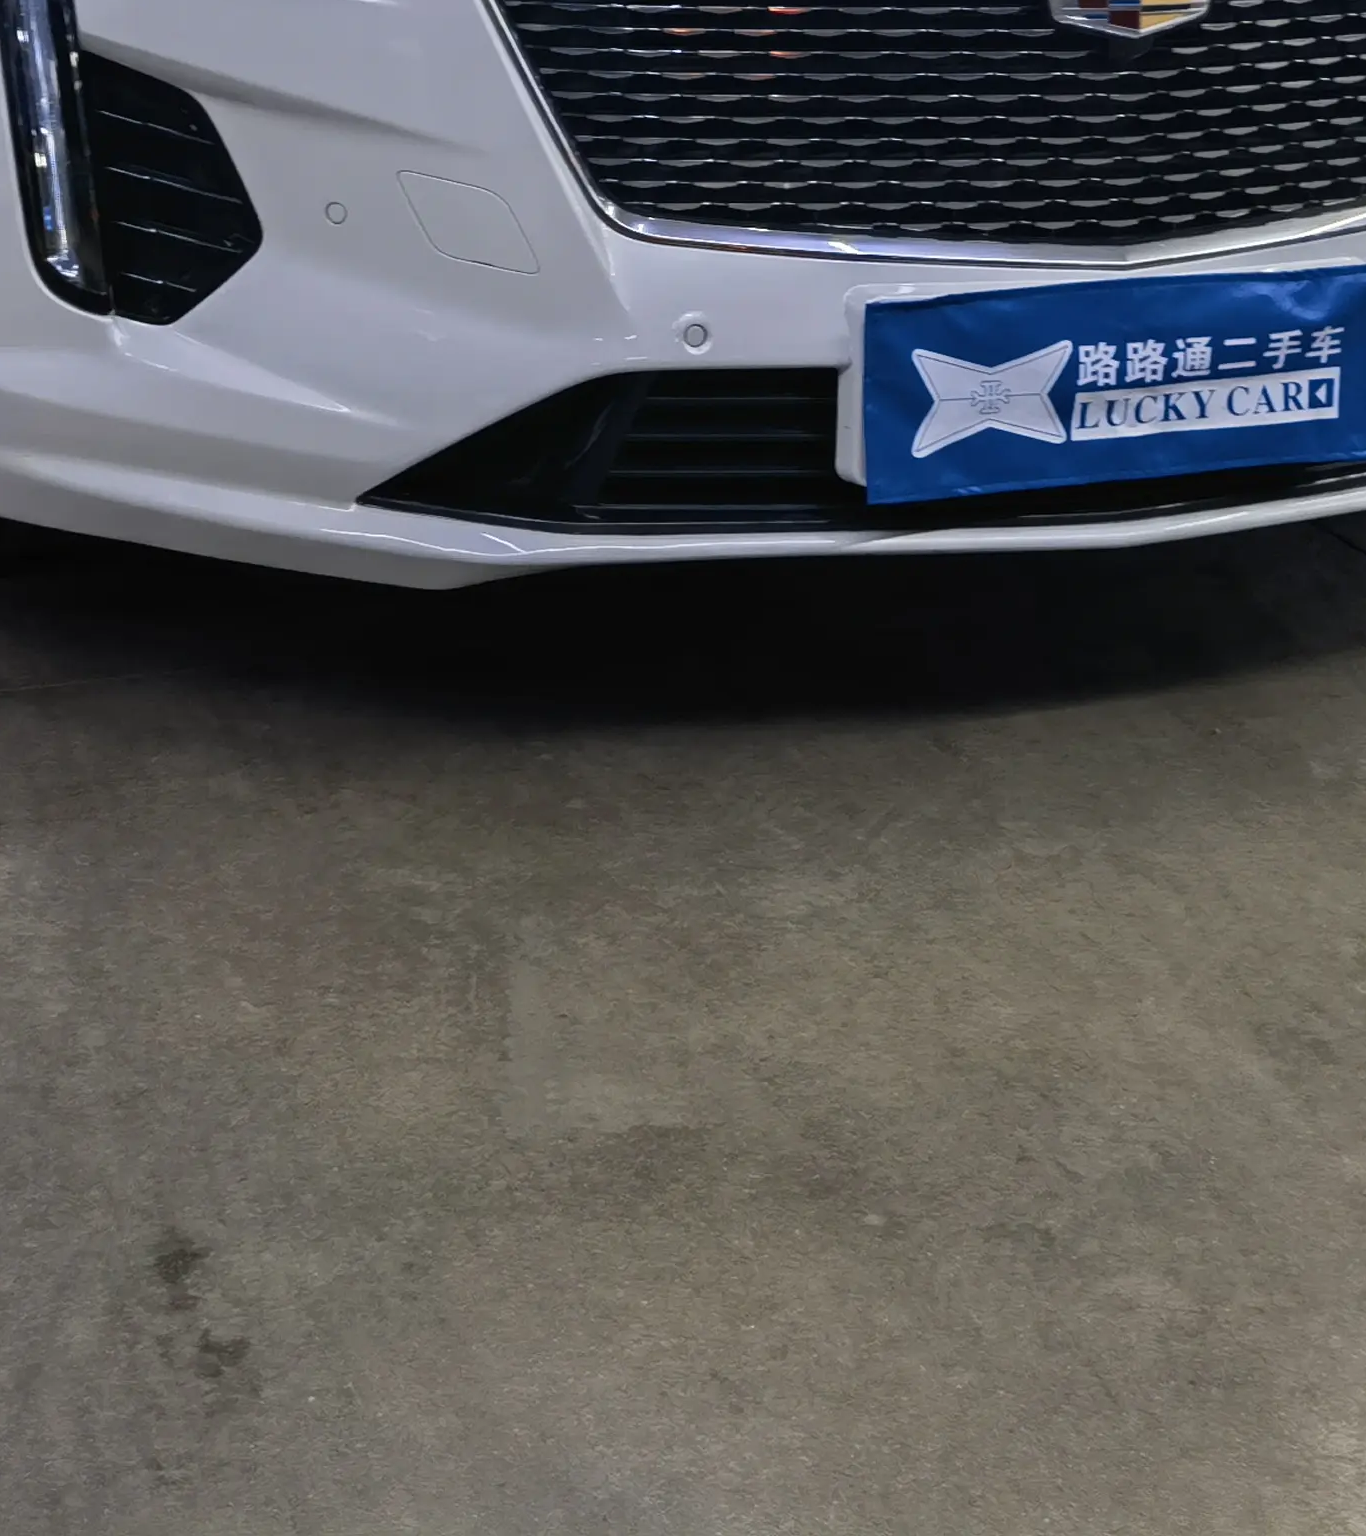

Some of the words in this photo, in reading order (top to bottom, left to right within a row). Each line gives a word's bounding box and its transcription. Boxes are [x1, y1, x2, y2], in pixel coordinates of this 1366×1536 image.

[1076, 326, 1345, 386] 路路通二手车
[1075, 389, 1215, 429] LUCKY
[1226, 380, 1304, 416] CAR
